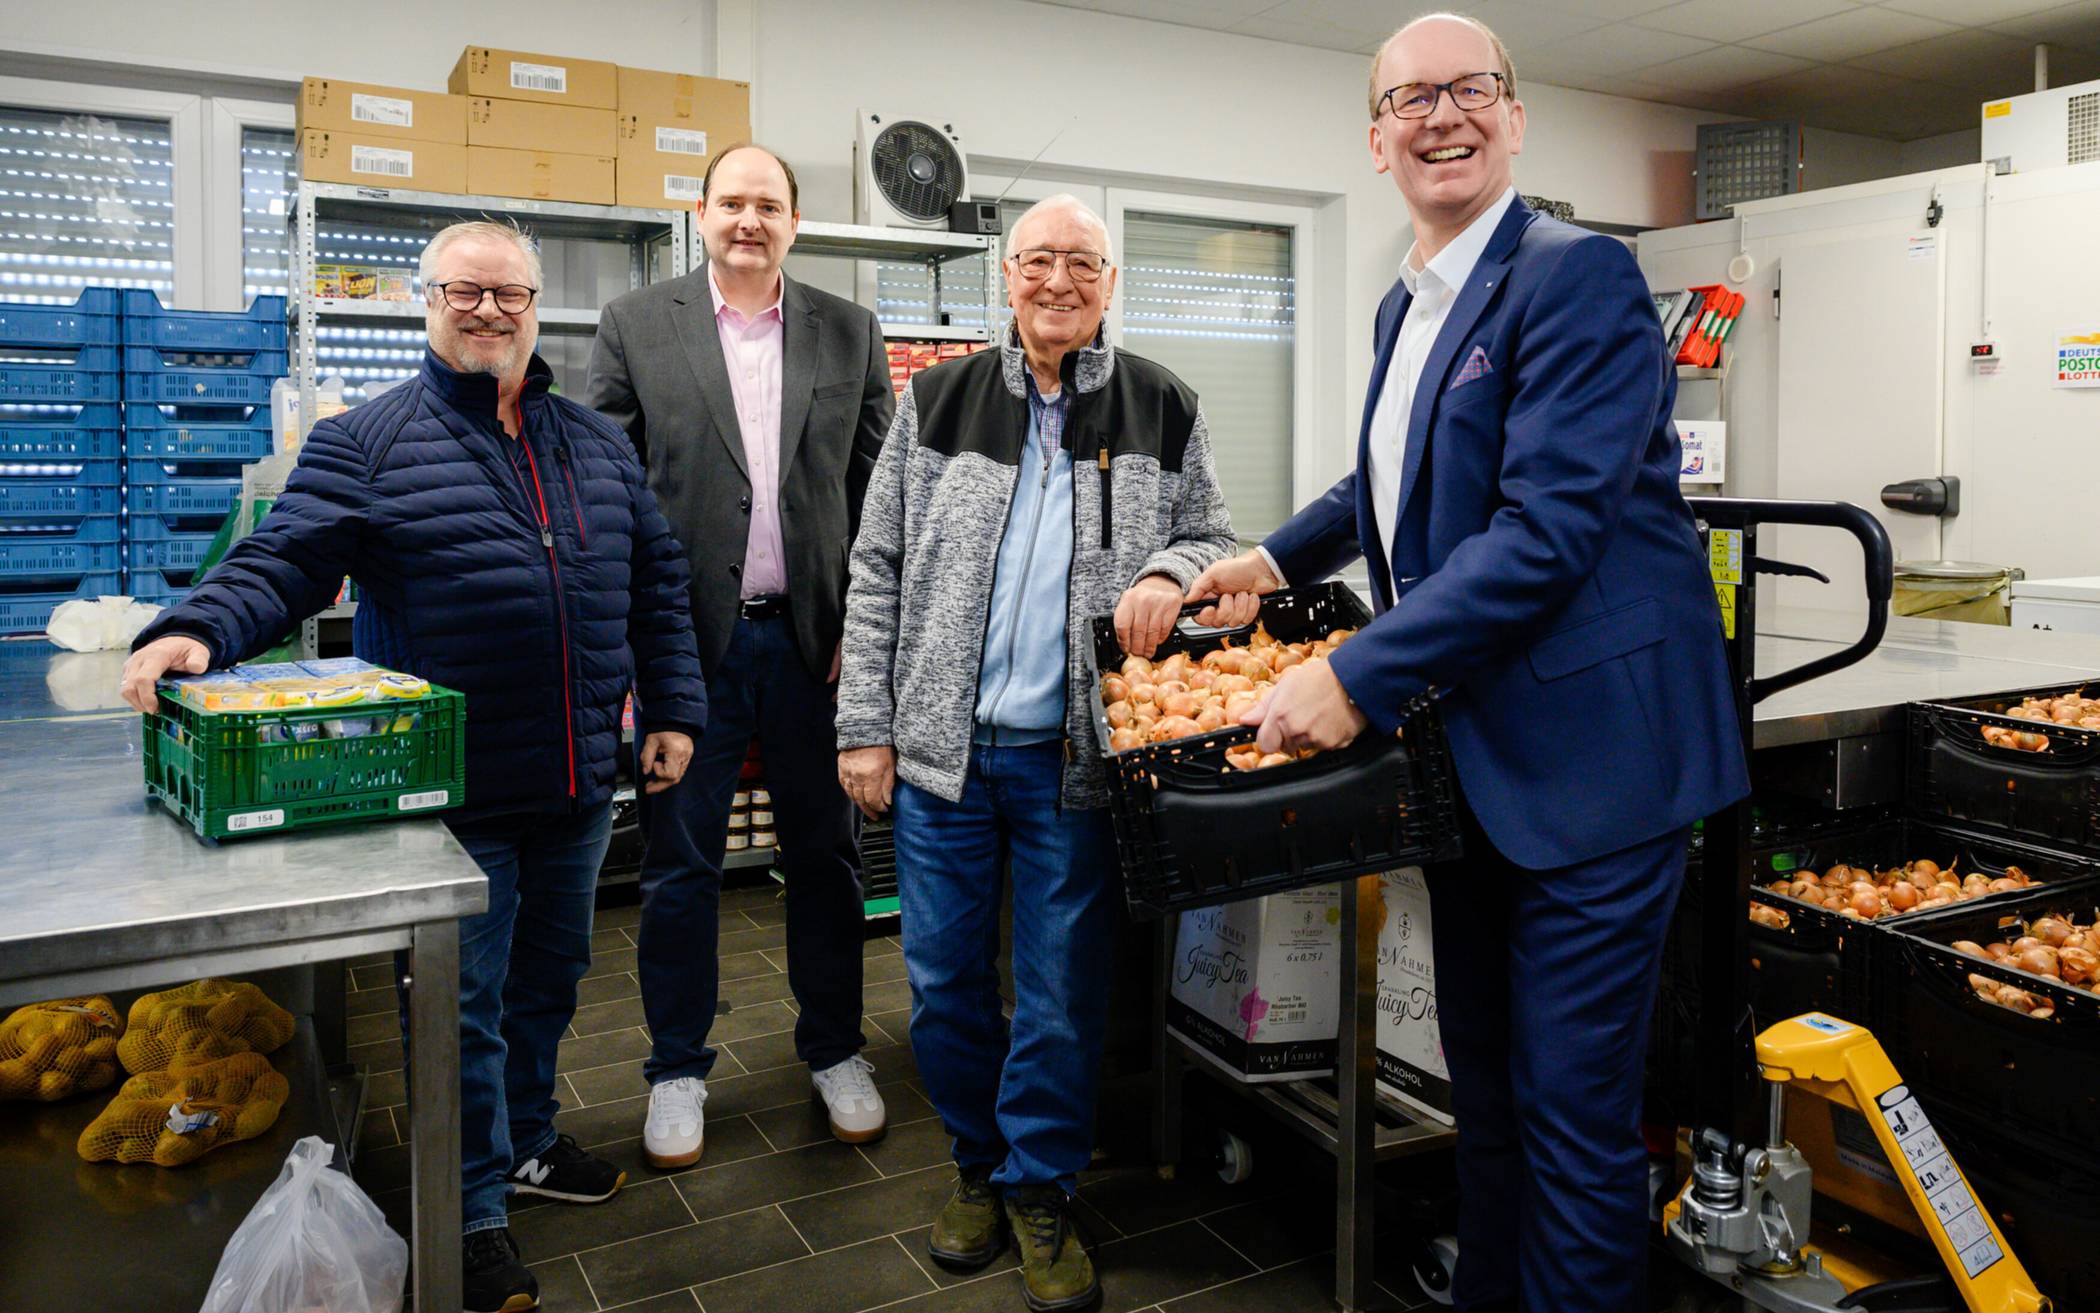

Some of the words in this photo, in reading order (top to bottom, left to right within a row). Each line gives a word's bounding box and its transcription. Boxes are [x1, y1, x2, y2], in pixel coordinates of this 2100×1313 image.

[257, 814, 273, 823] 154
[1177, 943, 1221, 989] Juicy
[1220, 951, 1249, 984] Tea
[1383, 1060, 1424, 1088] ALKOHOL
